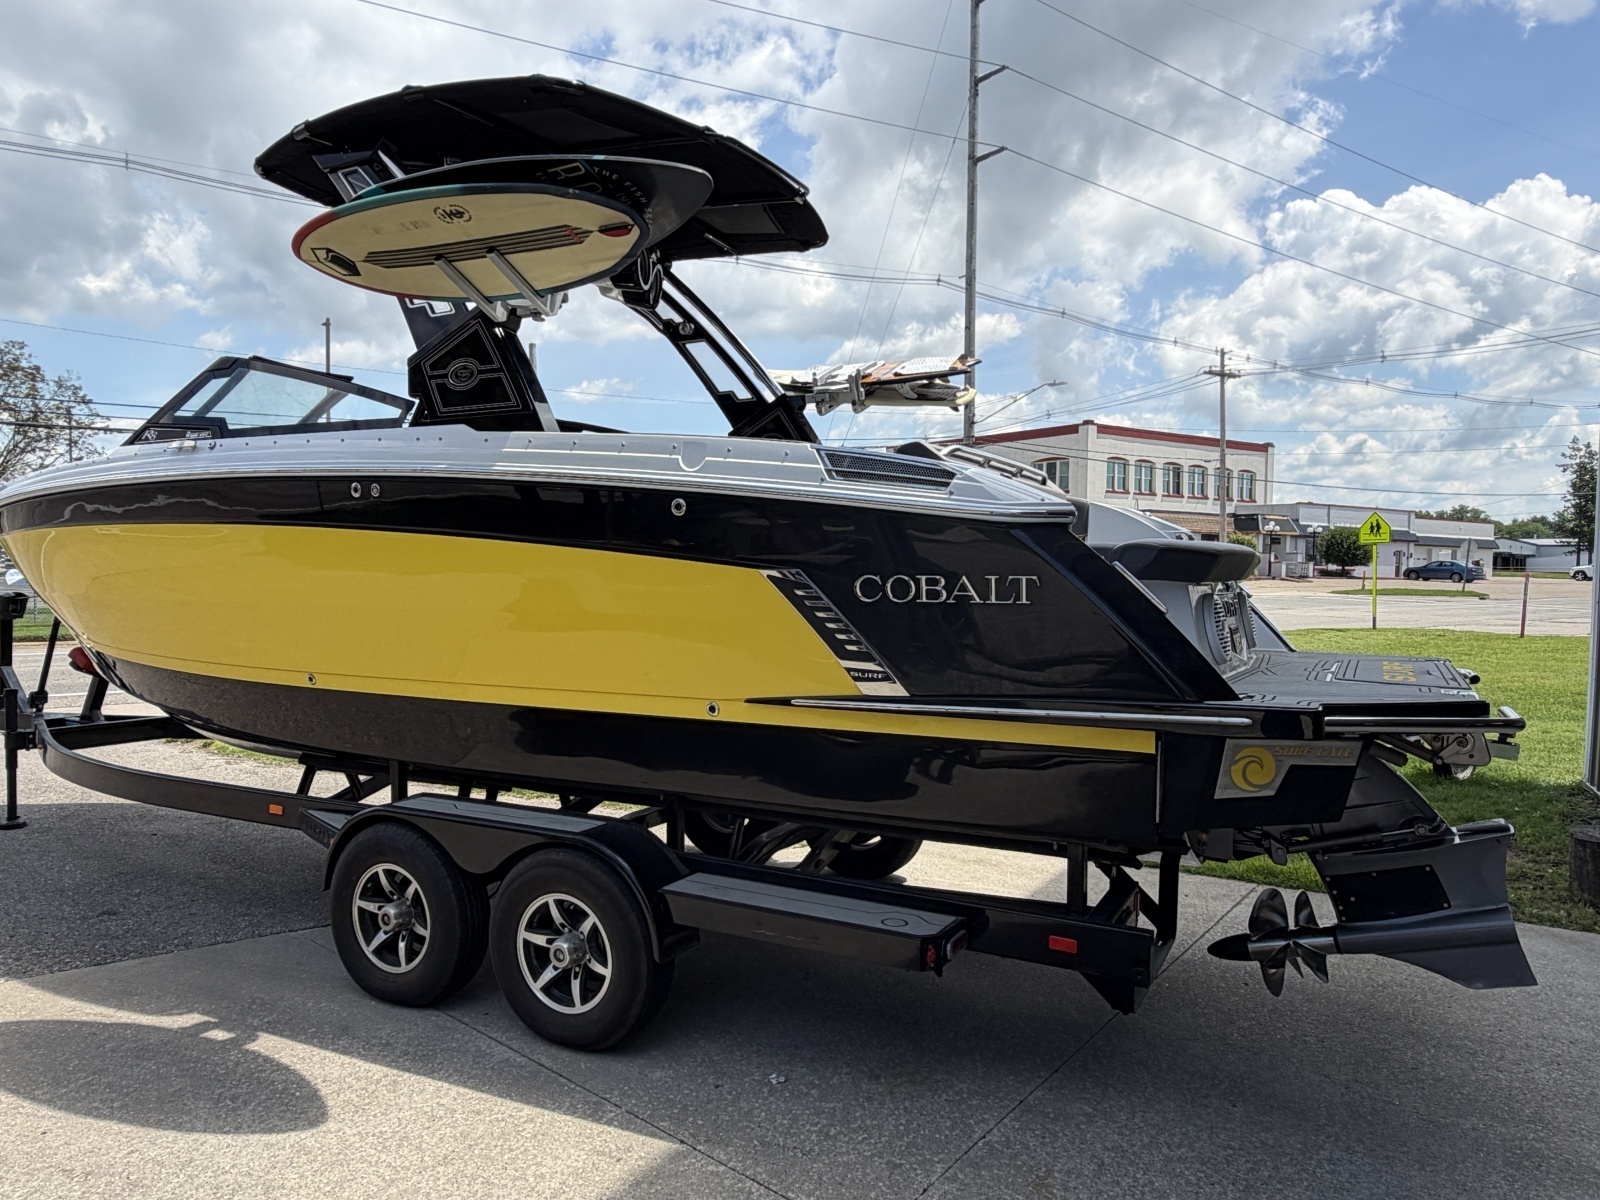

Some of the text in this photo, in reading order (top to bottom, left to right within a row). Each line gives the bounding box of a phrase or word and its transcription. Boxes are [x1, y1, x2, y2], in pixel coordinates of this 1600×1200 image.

[593, 166, 619, 181] THE
[624, 181, 648, 204] FISH
[853, 574, 1040, 604] COBALT
[850, 671, 888, 680] SURF
[1274, 746, 1314, 757] SURF
